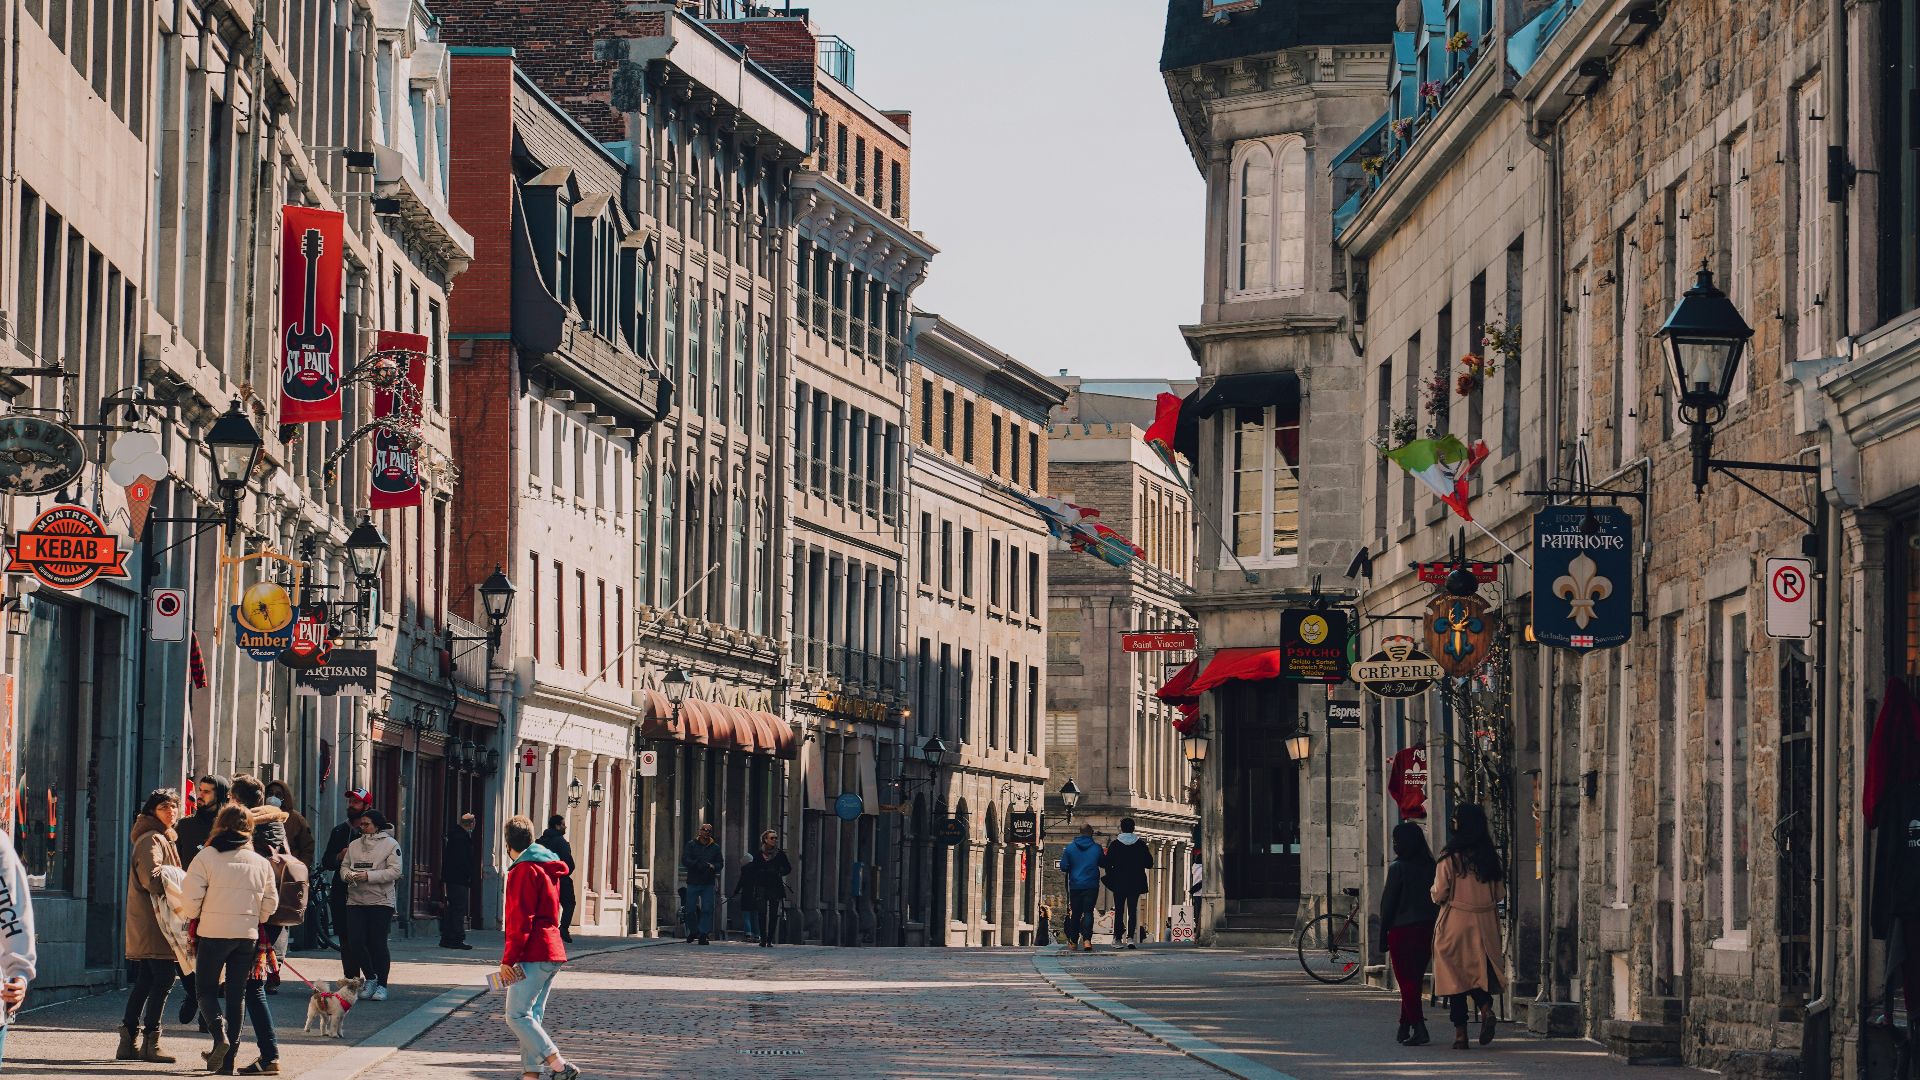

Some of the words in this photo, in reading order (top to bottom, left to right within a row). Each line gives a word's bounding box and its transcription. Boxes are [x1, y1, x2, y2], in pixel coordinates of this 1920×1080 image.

[286, 350, 302, 384] ST.
[304, 350, 334, 384] PAUL
[390, 451, 414, 479] PAUL
[37, 510, 99, 533] MONTREAL
[1556, 514, 1611, 524] BOUTUE
[36, 538, 98, 560] KEBAB
[1541, 534, 1624, 550] PATRIOTE
[240, 632, 288, 647] Amber
[299, 623, 326, 654] PAUL
[1132, 640, 1152, 648] Saint
[1156, 640, 1185, 648] Vincent
[1288, 648, 1340, 657] PSYCHO
[305, 666, 367, 678] ARTISANS
[1358, 664, 1440, 680] CRÊPERIE
